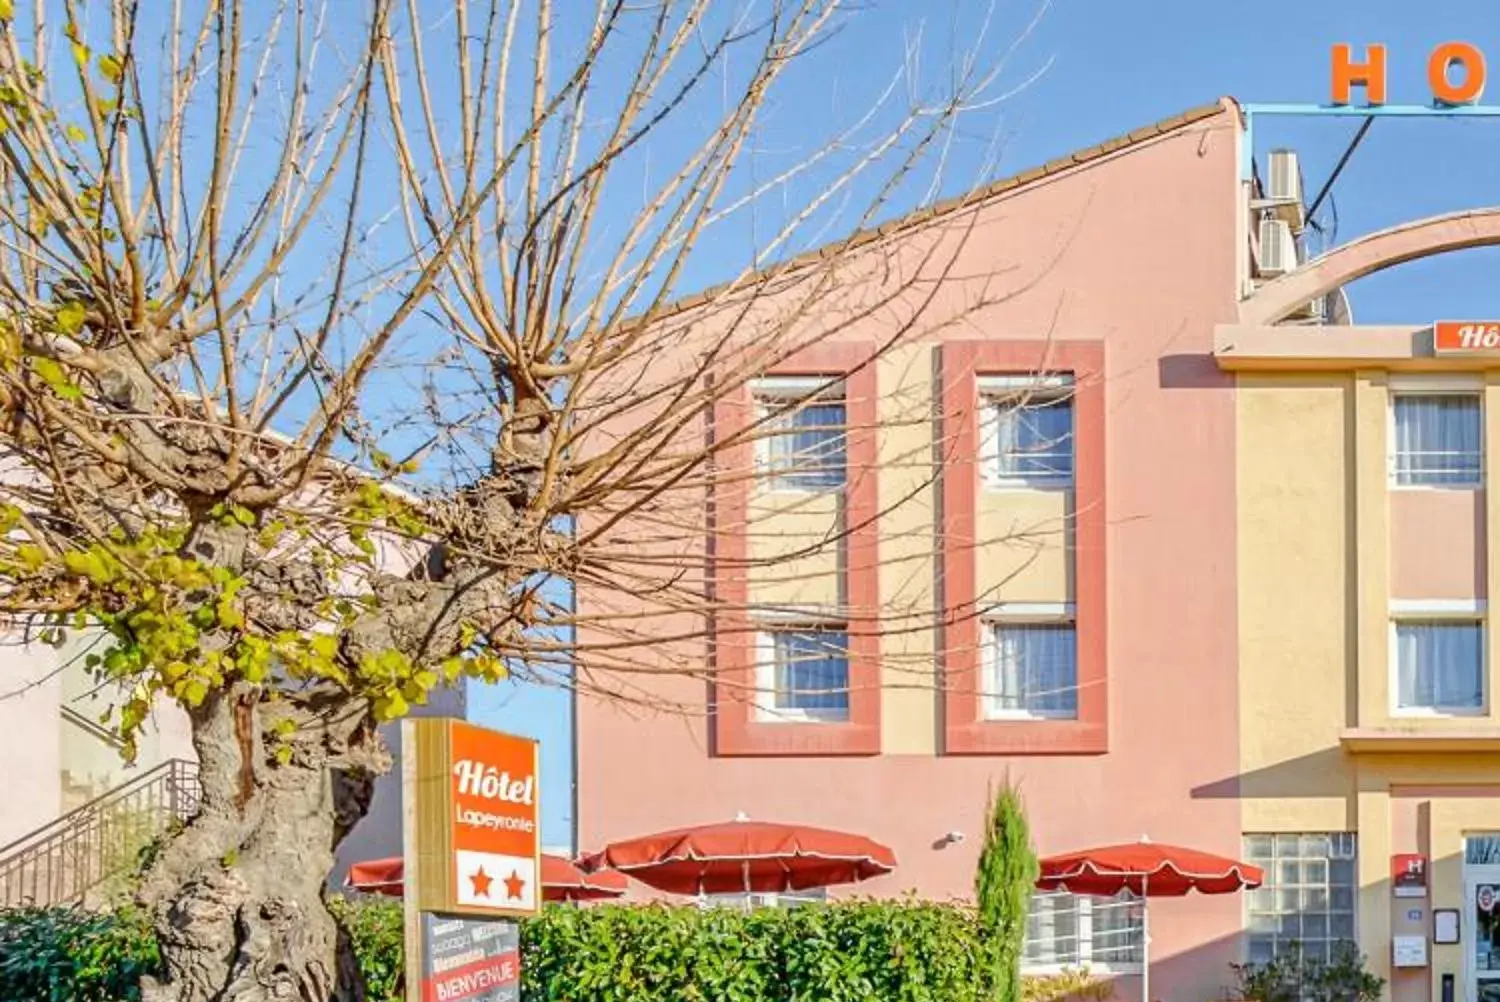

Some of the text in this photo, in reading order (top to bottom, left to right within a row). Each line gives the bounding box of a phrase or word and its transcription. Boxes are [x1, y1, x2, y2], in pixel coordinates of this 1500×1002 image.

[454, 759, 534, 806] Hôtel
[456, 803, 536, 832] Lapeyronie
[437, 961, 515, 1002] BIENVENUE
